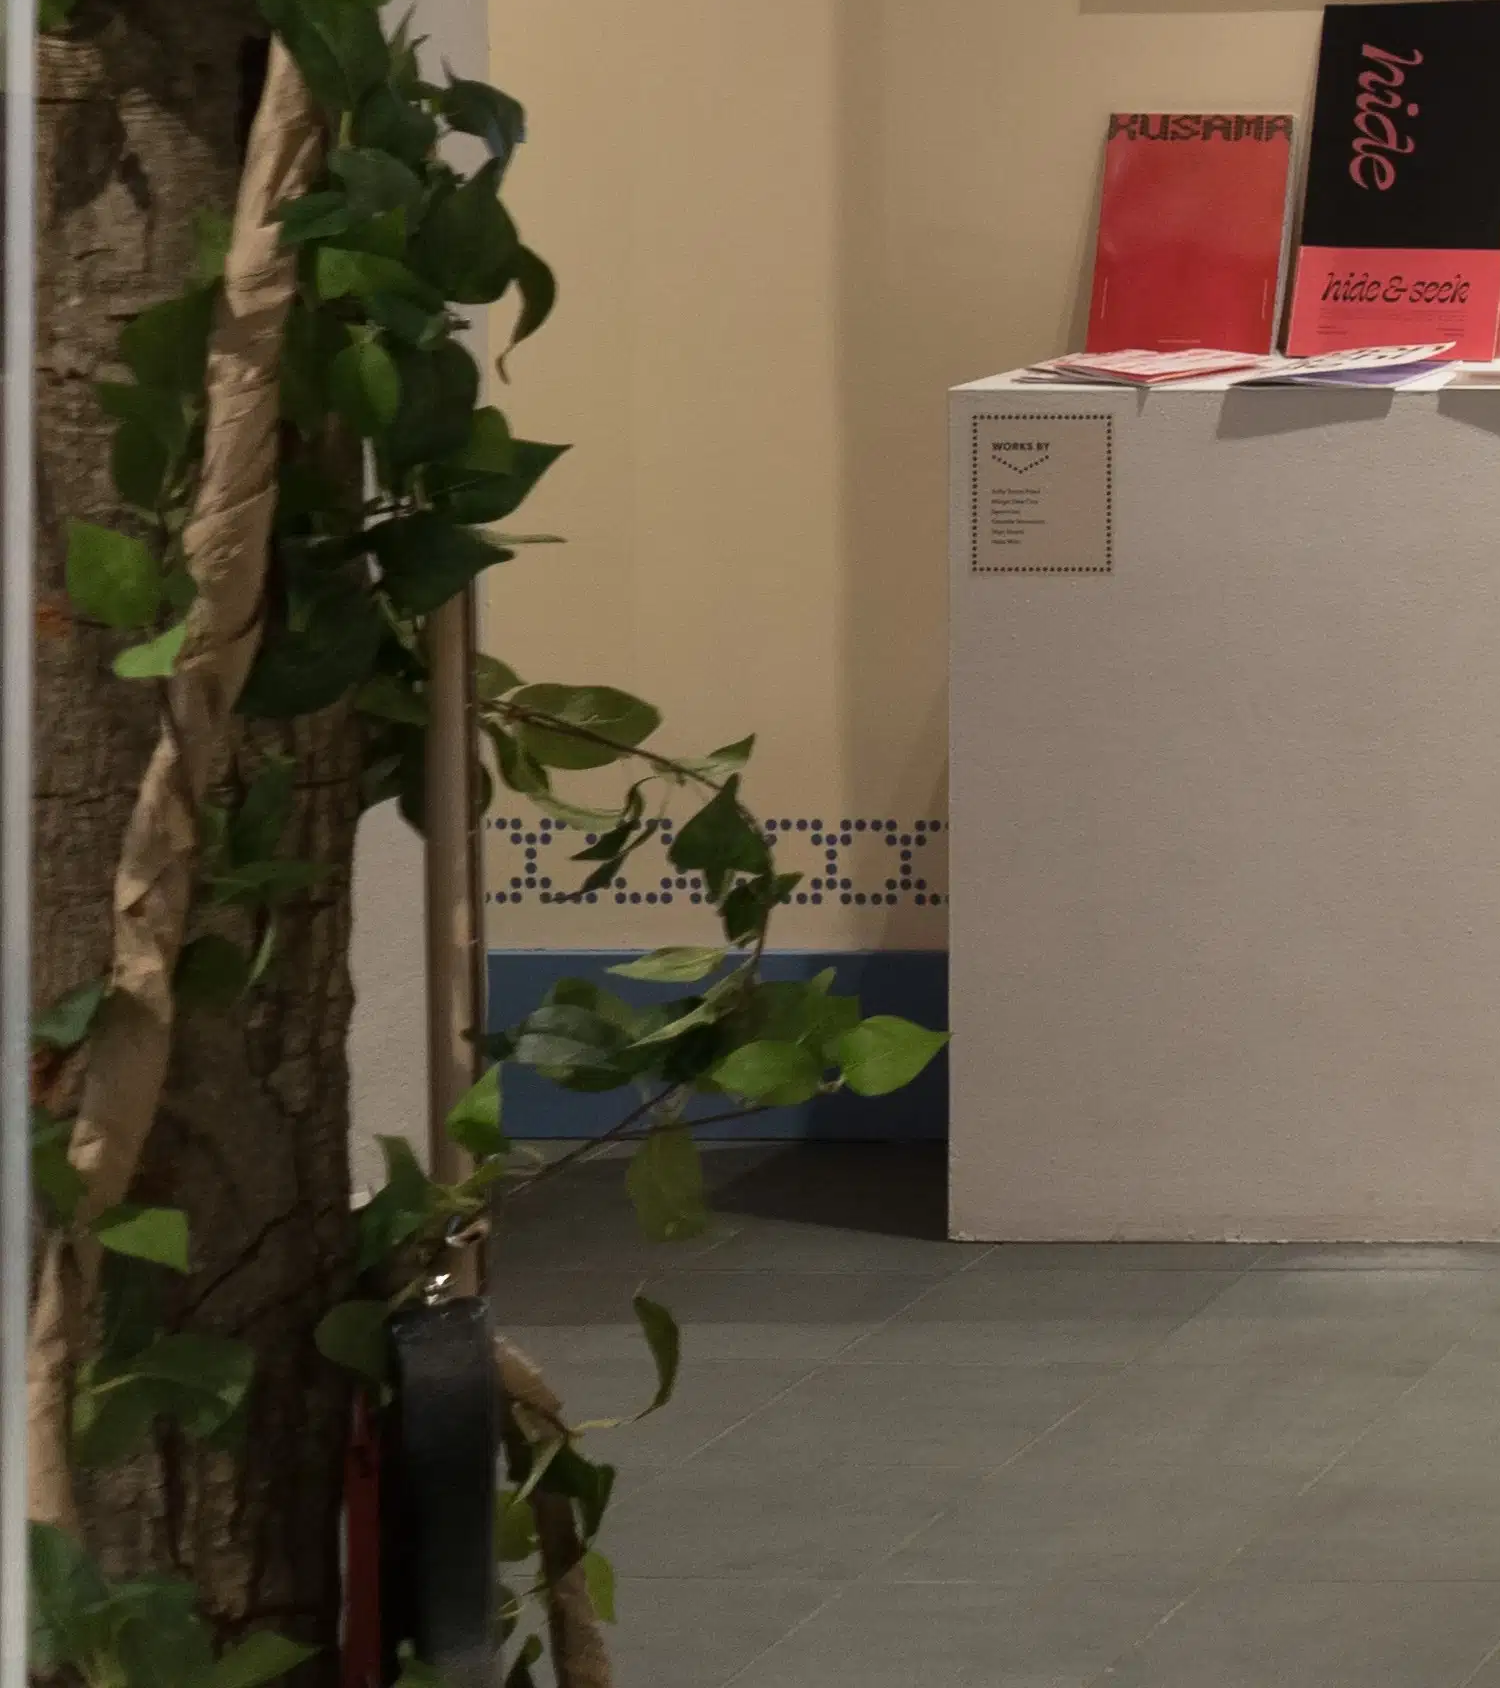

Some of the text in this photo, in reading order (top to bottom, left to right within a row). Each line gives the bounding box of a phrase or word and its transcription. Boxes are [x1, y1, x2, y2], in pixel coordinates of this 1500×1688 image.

[1107, 113, 1293, 141] KUSAMA
[1349, 43, 1424, 191] hide
[1320, 272, 1471, 304] hide & seek
[992, 442, 1050, 451] WORKS BY
